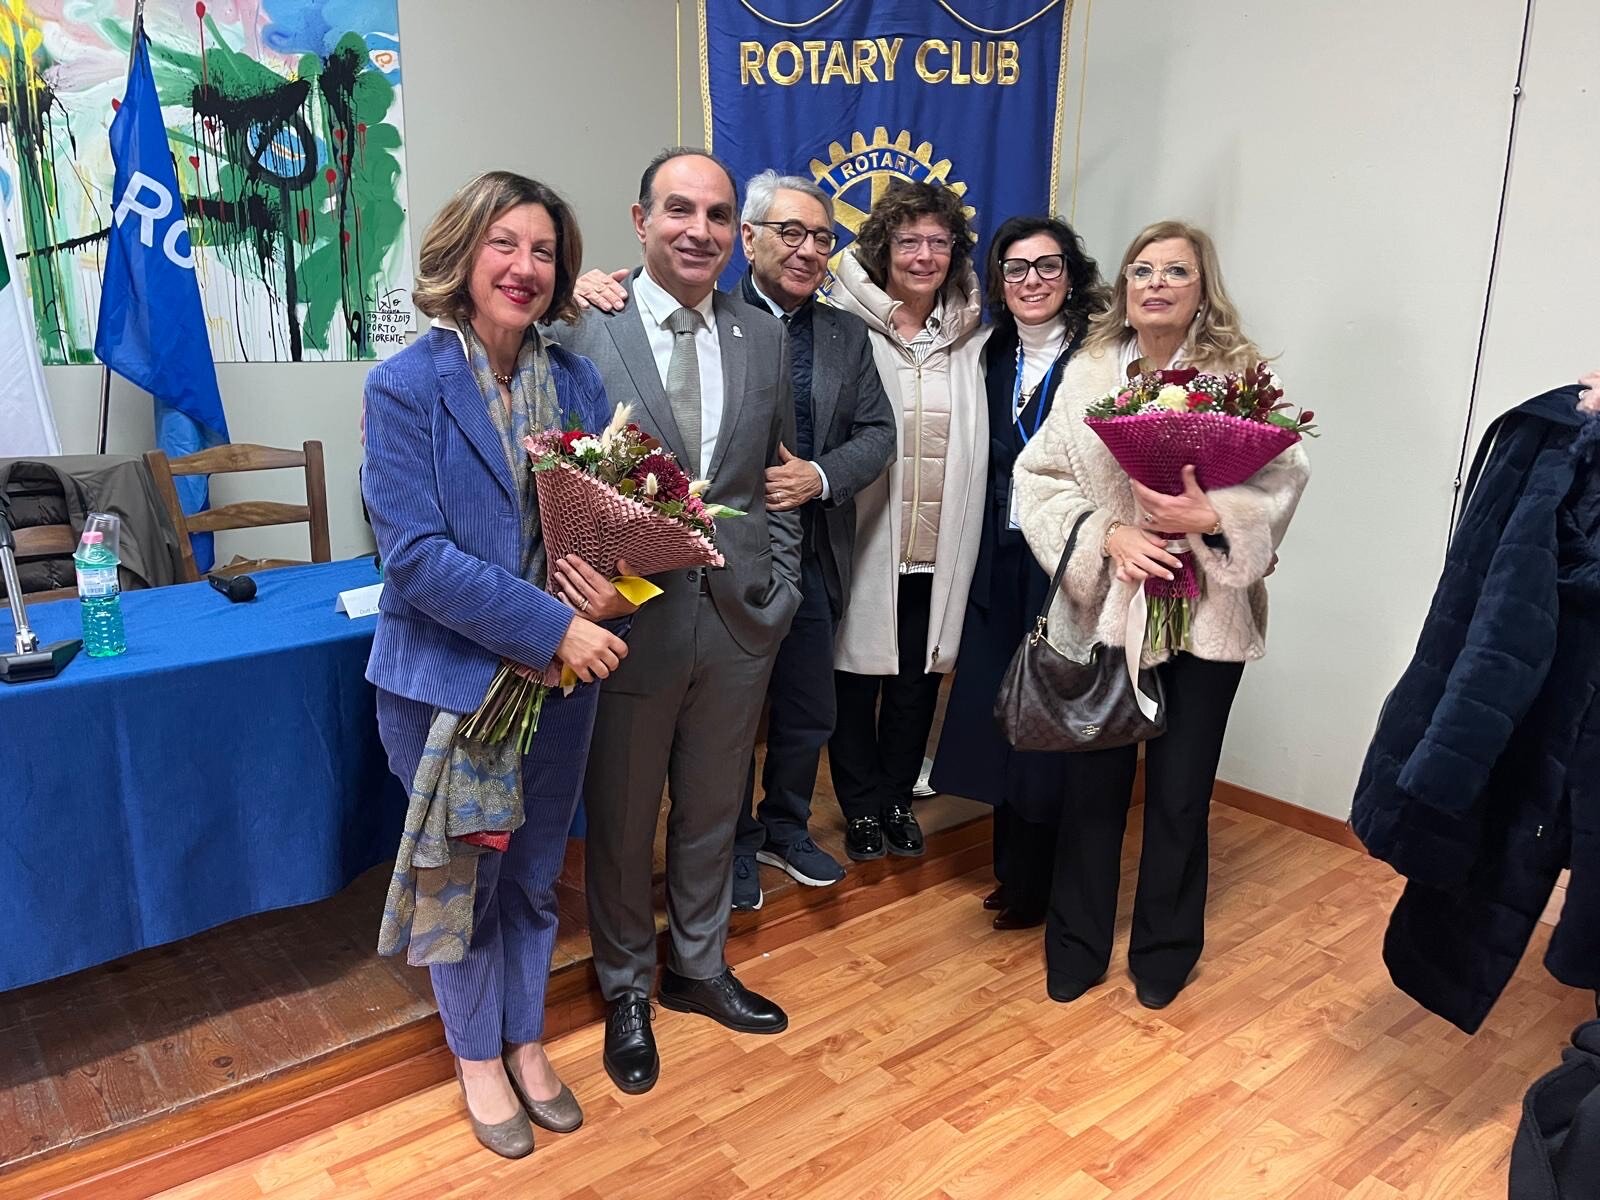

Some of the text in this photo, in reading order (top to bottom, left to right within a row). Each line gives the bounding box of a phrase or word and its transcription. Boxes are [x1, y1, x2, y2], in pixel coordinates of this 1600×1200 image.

[739, 37, 1020, 85] ROTARY CLUB
[840, 151, 920, 180] ROTARY
[367, 324, 397, 333] PORTO
